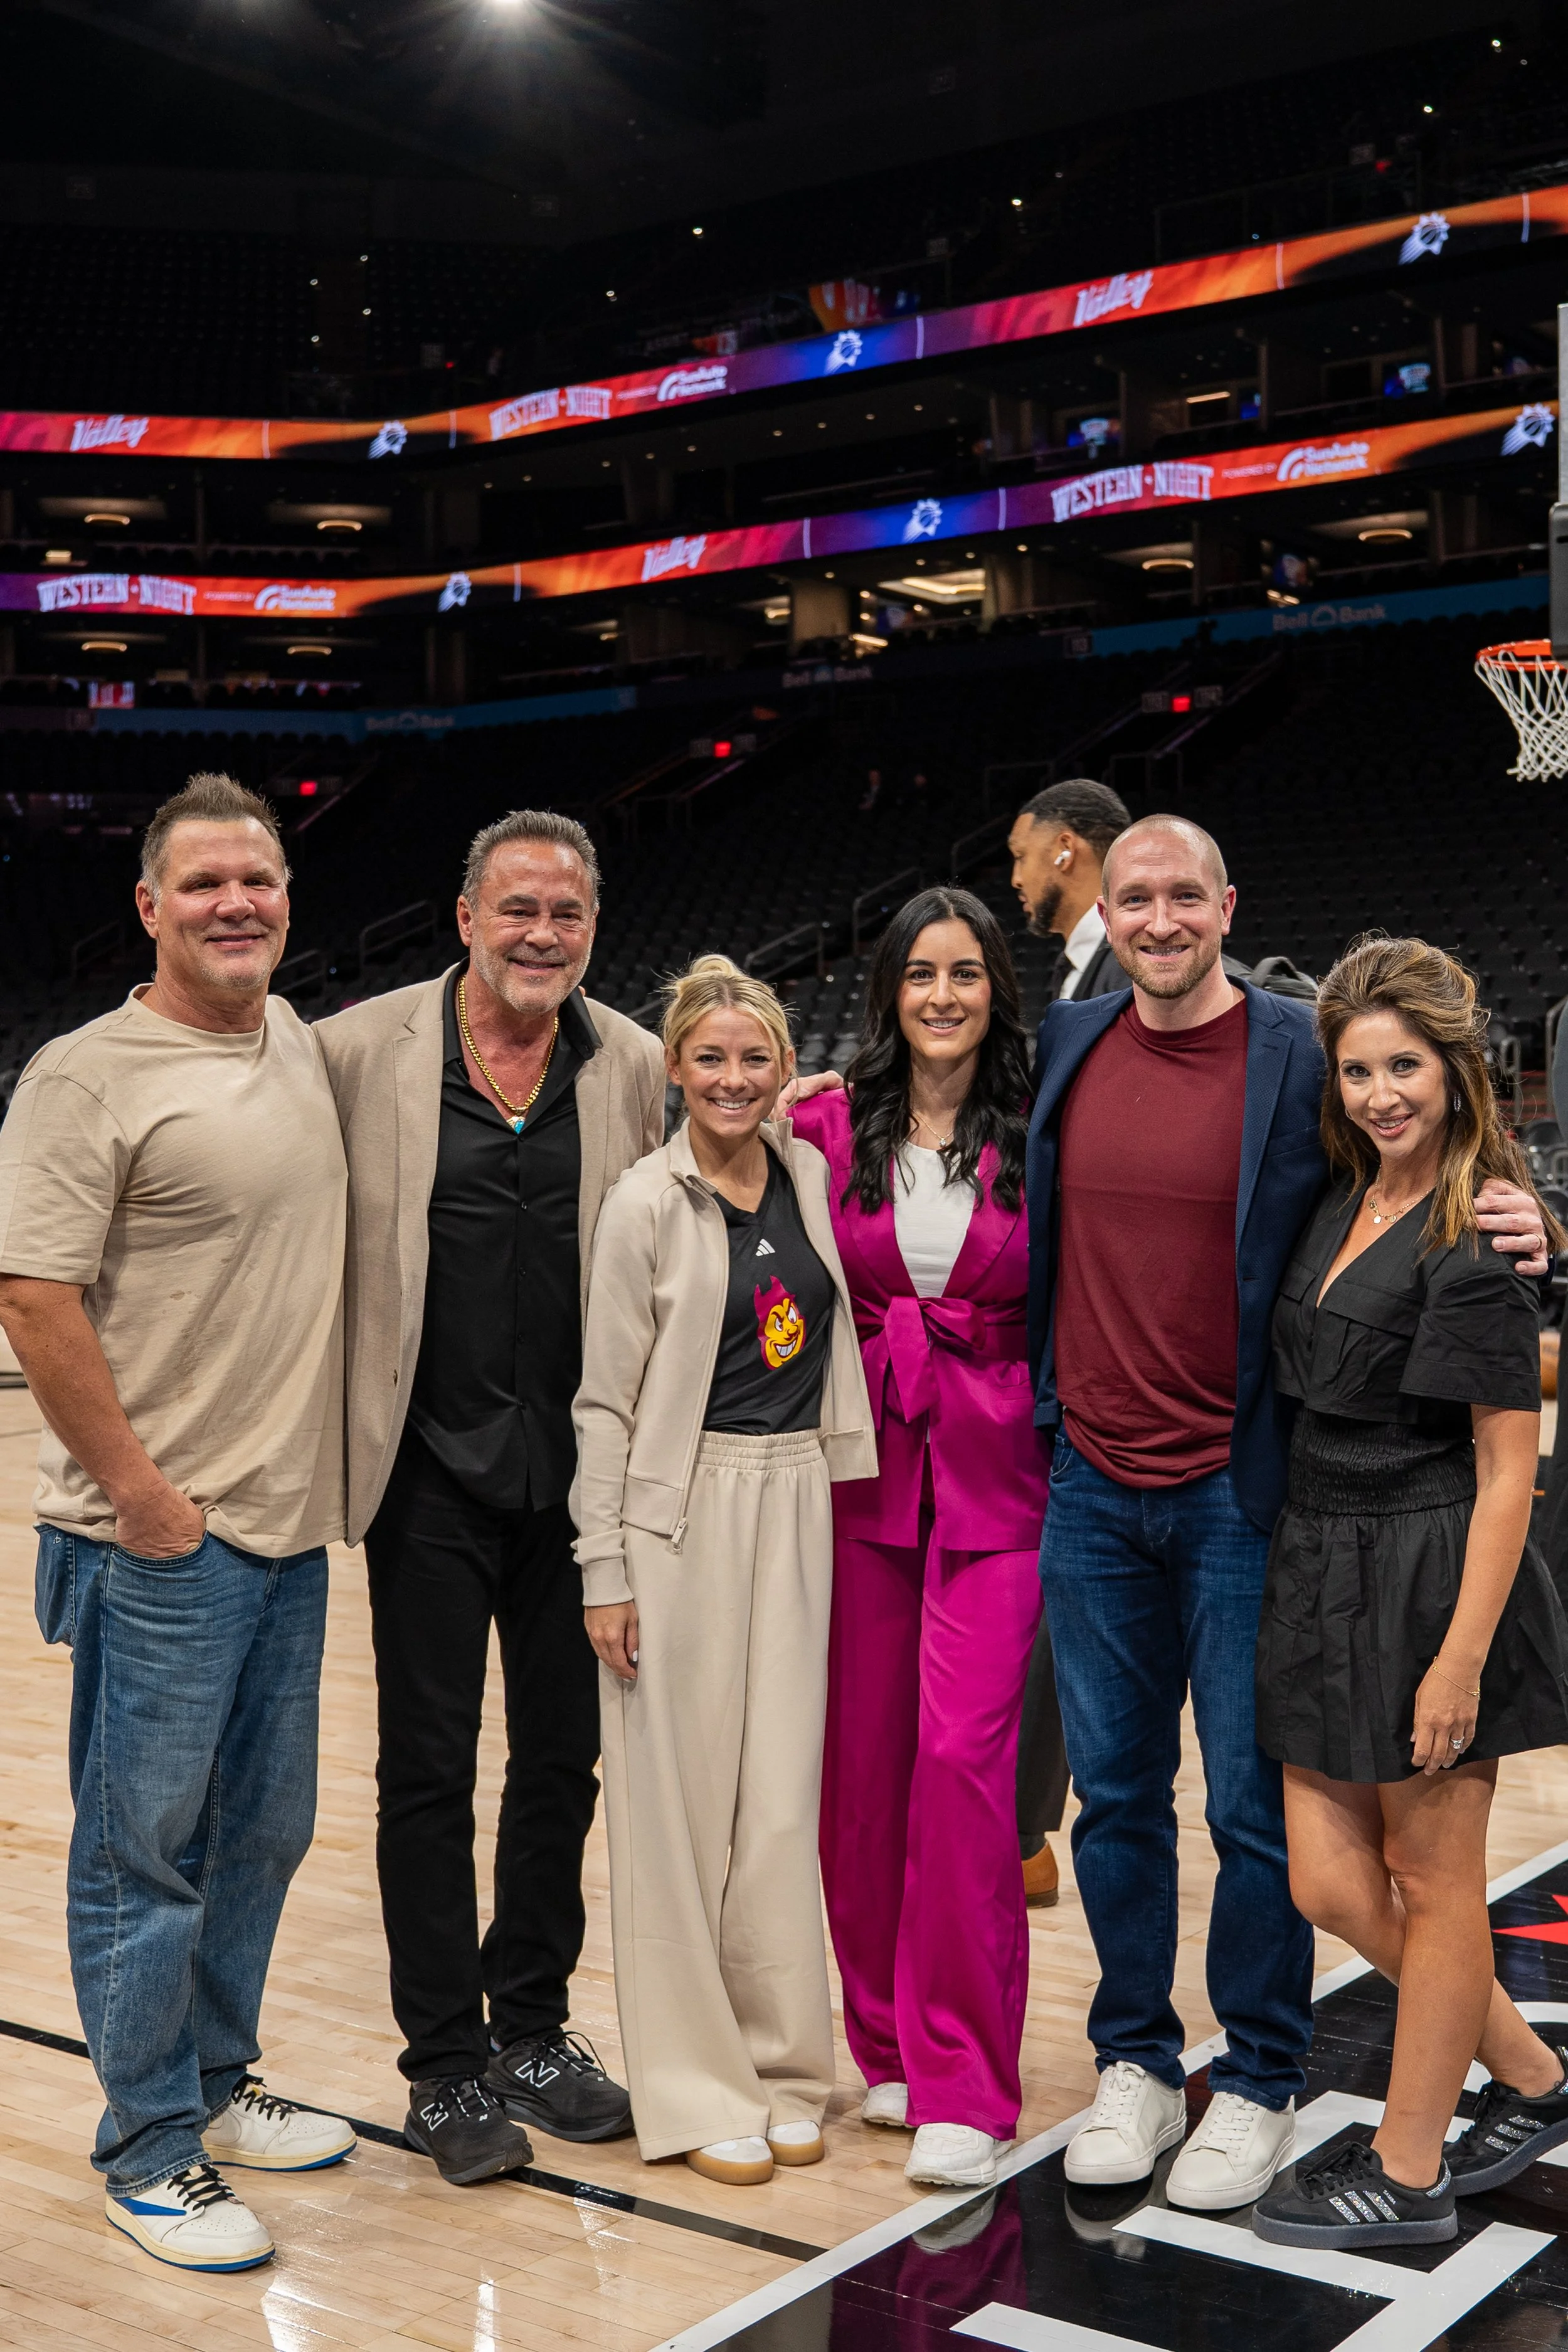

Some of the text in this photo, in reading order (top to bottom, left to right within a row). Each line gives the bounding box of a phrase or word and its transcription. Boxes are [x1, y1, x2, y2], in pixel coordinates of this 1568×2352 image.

[488, 385, 612, 442] WESTERN NIGHT
[1051, 465, 1144, 522] WESTERN
[1153, 462, 1214, 501] NIGHT
[36, 574, 130, 612] WESTERN
[138, 575, 198, 615] NIGHT
[1272, 603, 1386, 632] Bell Bank
[1383, 2190, 1396, 2205] SAMBA
